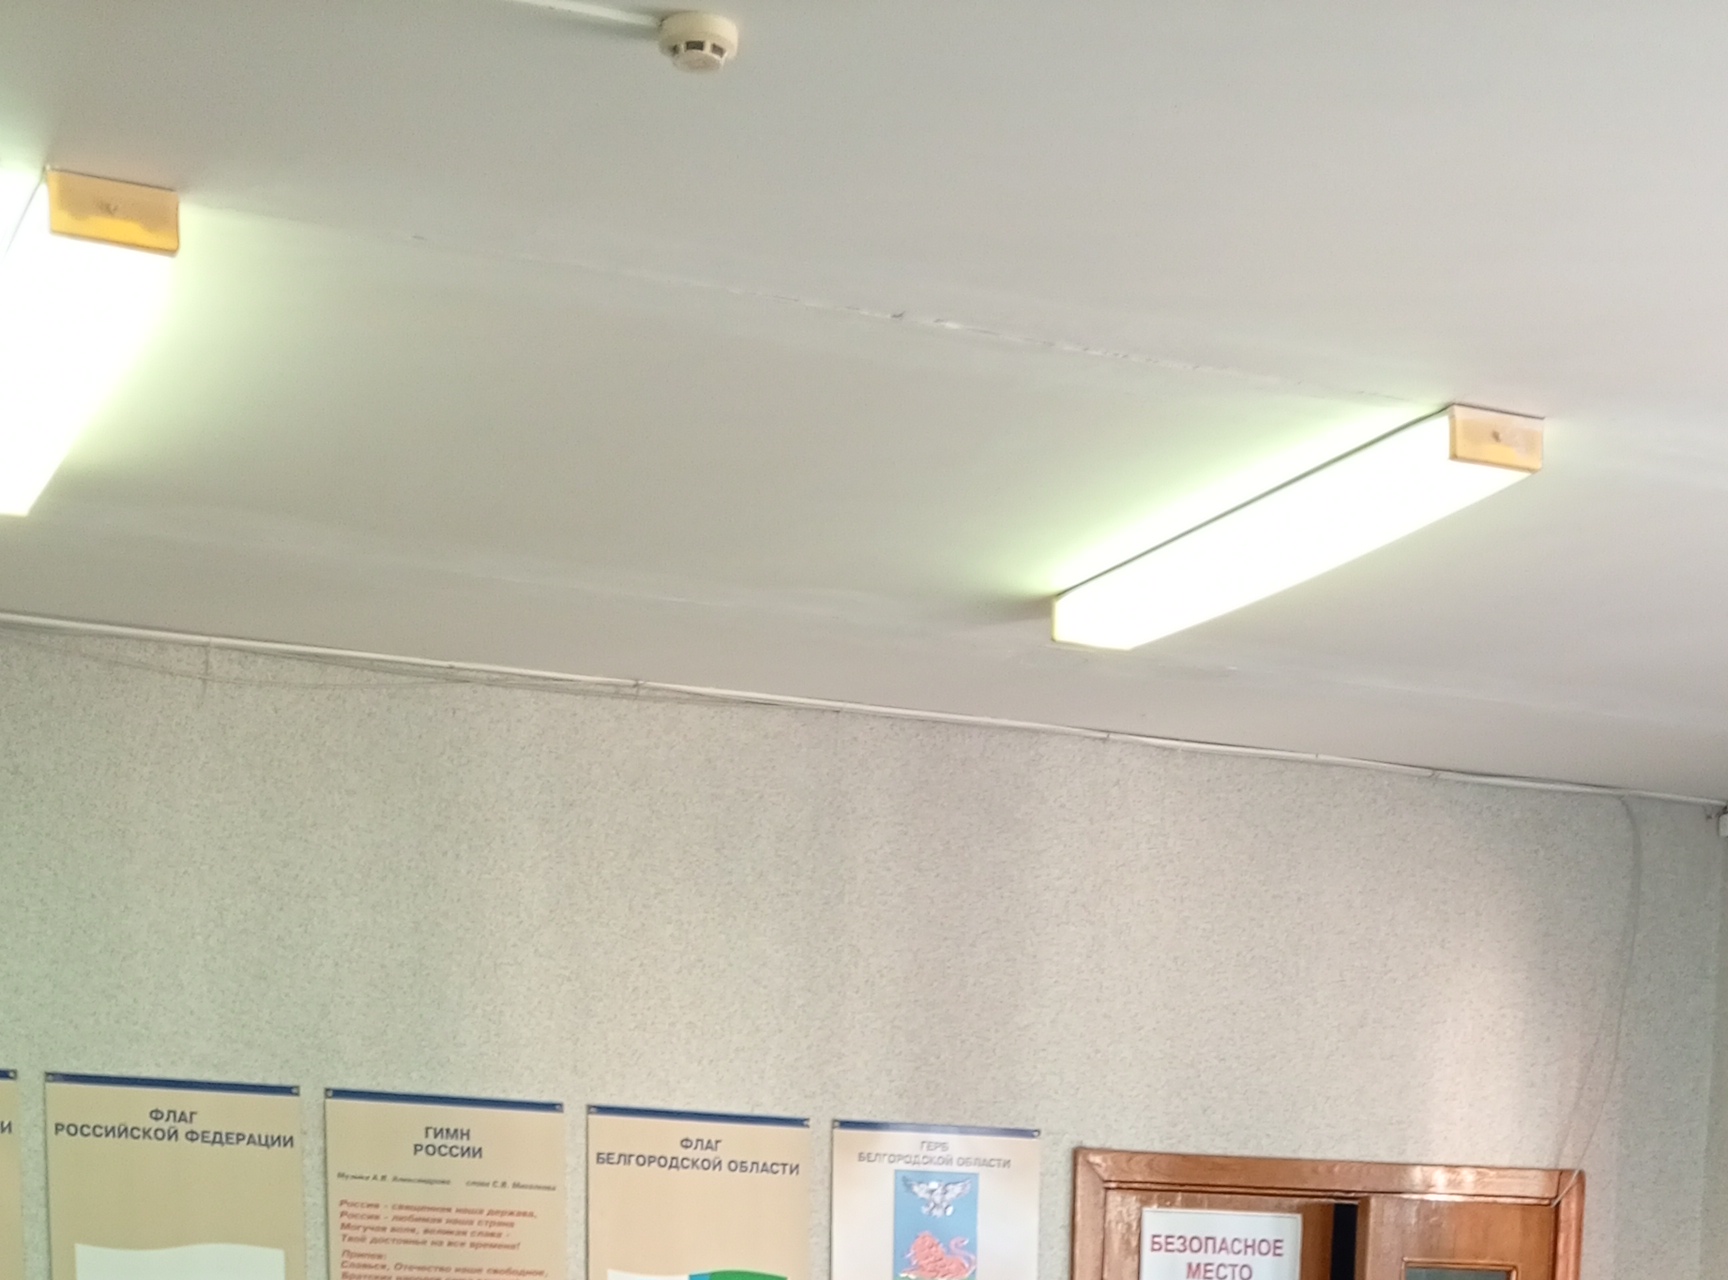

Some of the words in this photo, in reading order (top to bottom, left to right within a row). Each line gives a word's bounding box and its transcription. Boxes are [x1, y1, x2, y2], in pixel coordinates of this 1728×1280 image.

[149, 1108, 198, 1124] ФЛАГ
[54, 1122, 179, 1142] РОССИЙСКОЙ
[184, 1129, 294, 1149] ФЕДЕРАЦИИ
[424, 1126, 471, 1141] ГИМН
[413, 1143, 483, 1159] РОССИИ
[680, 1137, 722, 1151] ФЛАГ
[920, 1140, 949, 1152] ГЕРБ
[596, 1152, 722, 1171] БЕЛГОРОДСКОЙ
[728, 1160, 800, 1176] ОБЛАСТИ
[858, 1152, 953, 1166] БЕЛГОРОДСКОЙ
[957, 1157, 1011, 1169] ОБЛАСТИ
[1150, 1234, 1284, 1257] БЕЗОПАСНОЕ
[1186, 1262, 1253, 1280] МЕСТО
